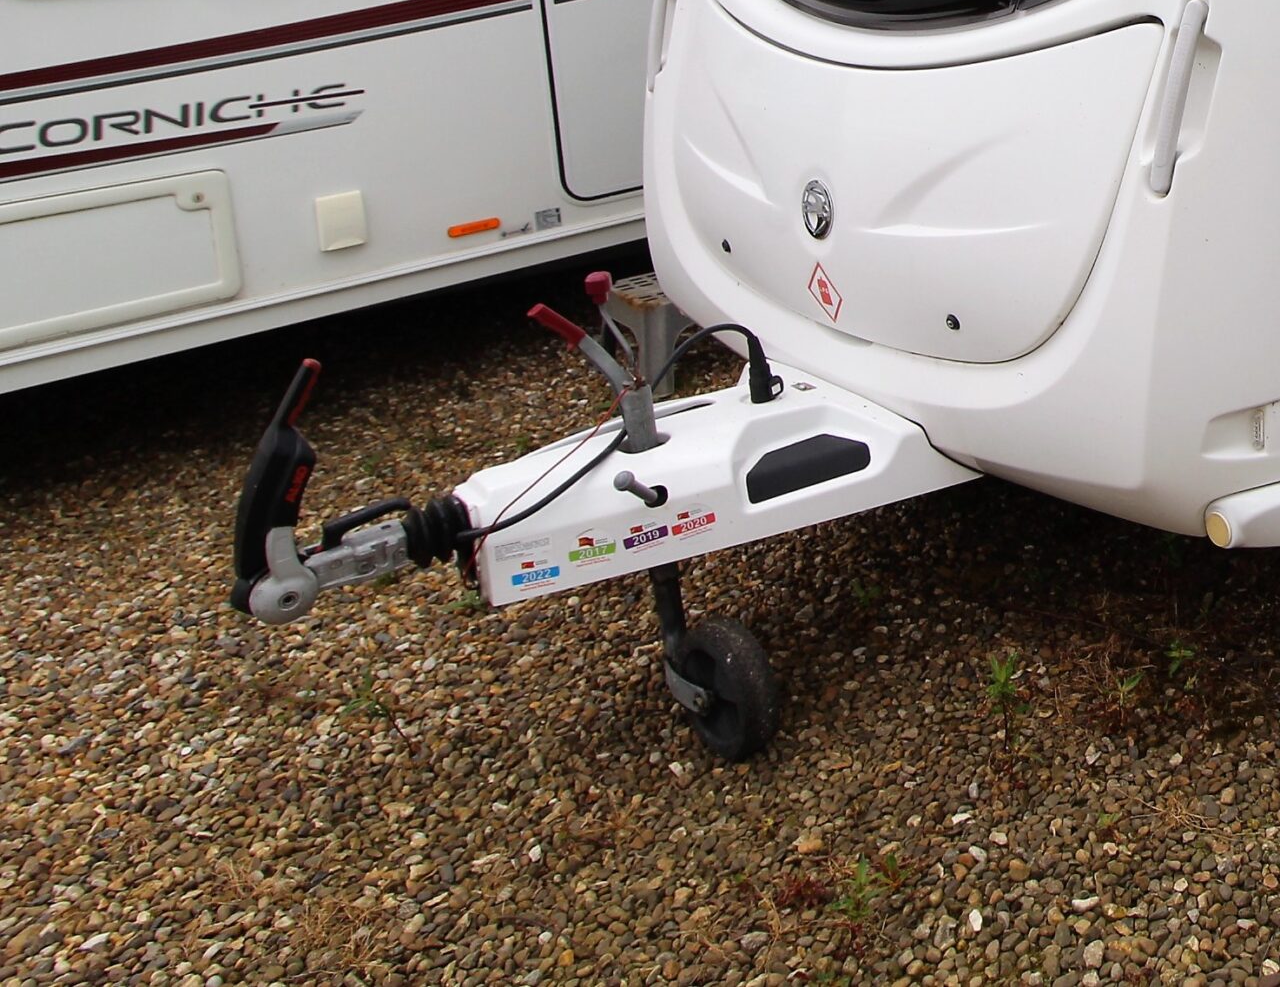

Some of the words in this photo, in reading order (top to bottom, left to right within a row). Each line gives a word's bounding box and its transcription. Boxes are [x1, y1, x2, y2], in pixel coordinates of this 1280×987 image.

[0, 83, 365, 155] CORNICHE
[681, 516, 707, 532] 2020
[631, 529, 660, 545] 2019
[579, 545, 608, 559] 2017
[521, 568, 552, 583] 2022
